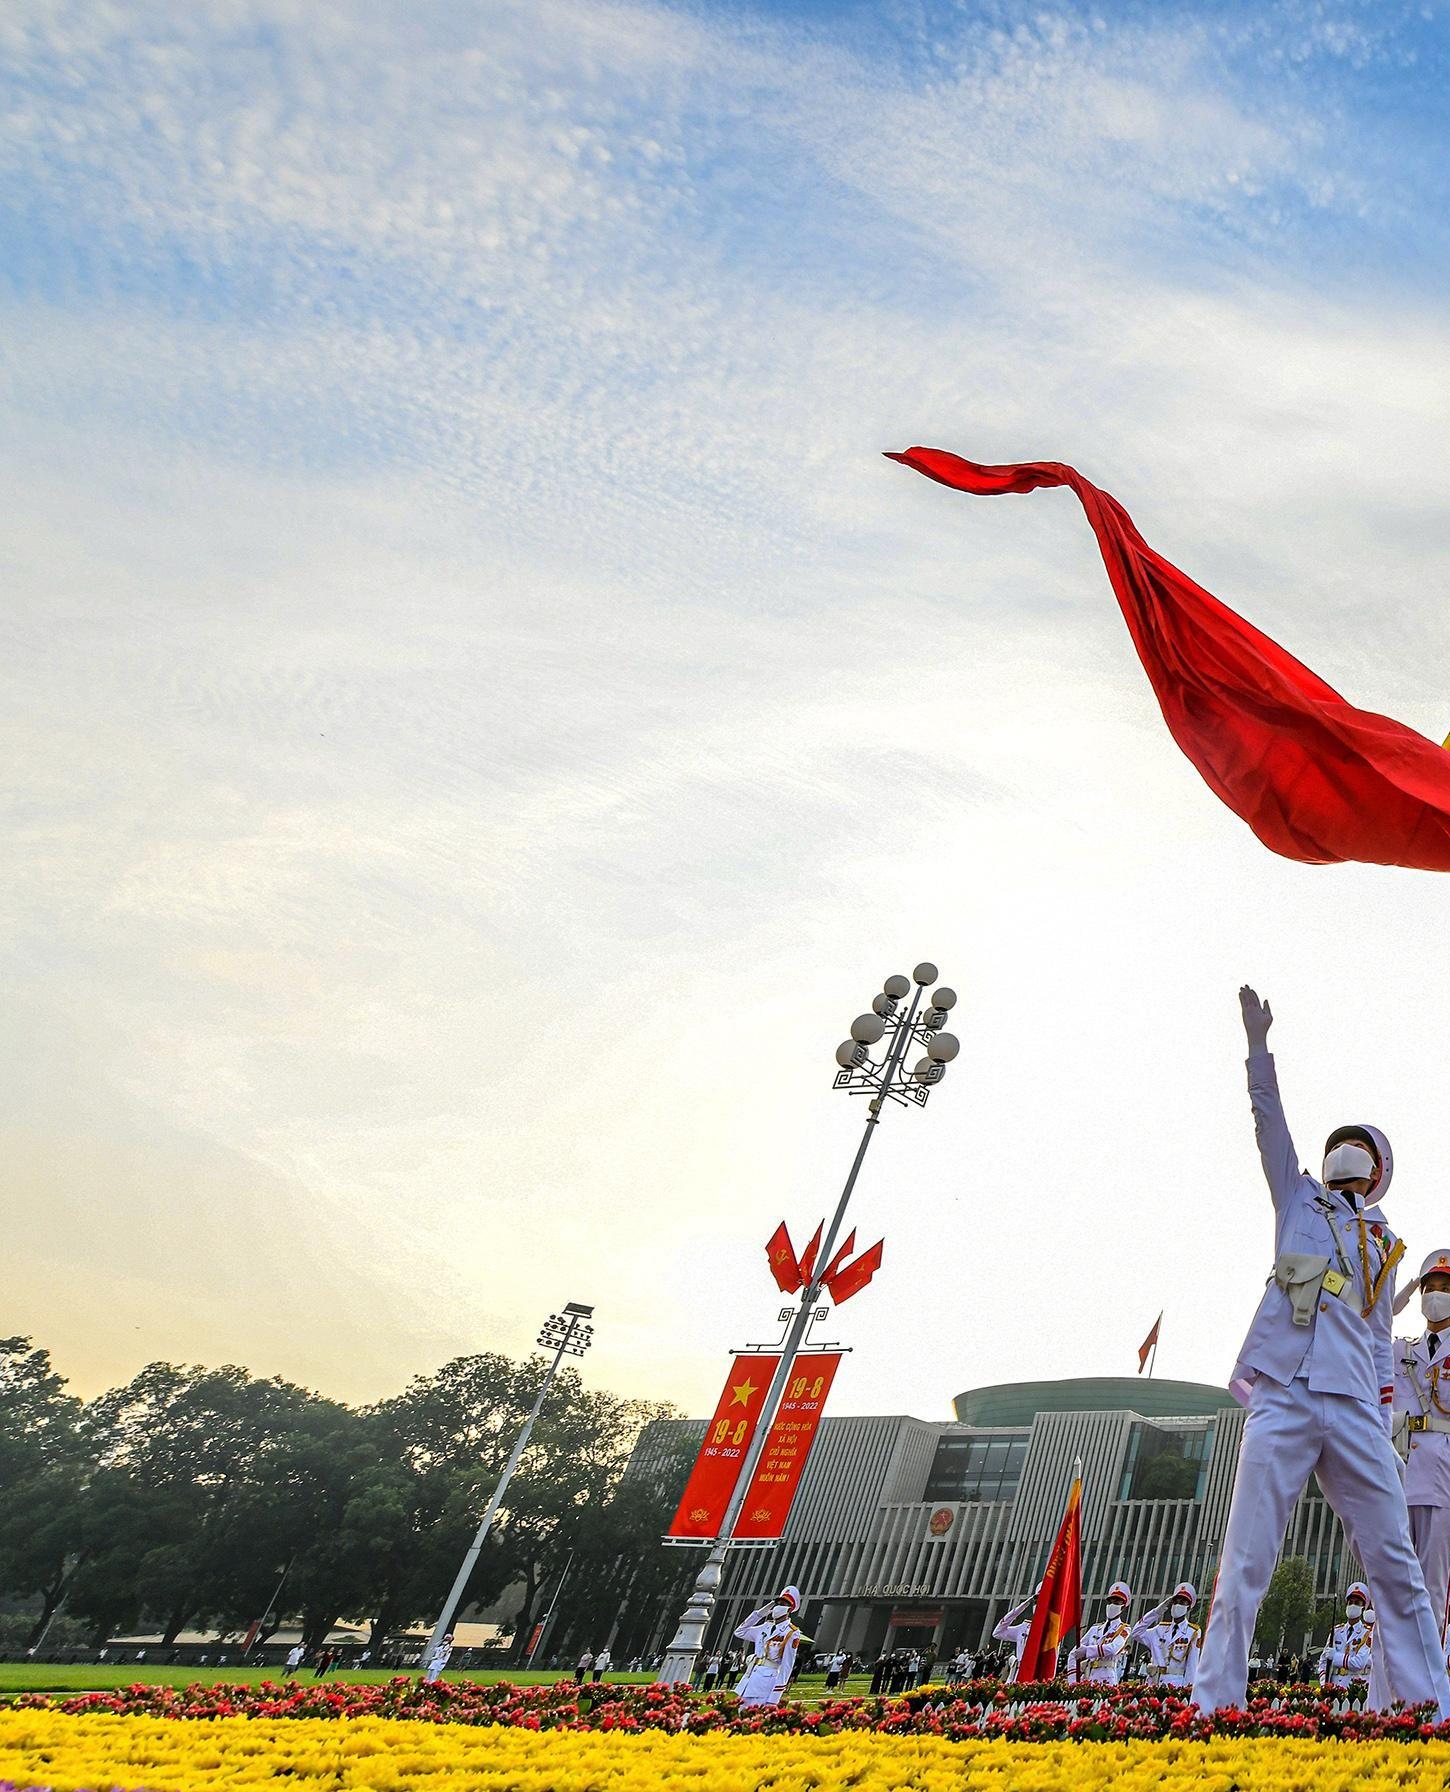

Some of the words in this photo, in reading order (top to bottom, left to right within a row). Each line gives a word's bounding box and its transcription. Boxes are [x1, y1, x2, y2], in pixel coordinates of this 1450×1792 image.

[788, 1376, 824, 1399] 19-8
[782, 1402, 796, 1410] 1945
[800, 1402, 818, 1410] 2022
[711, 1419, 748, 1445] 19-8
[704, 1448, 718, 1456] 1945
[721, 1448, 740, 1458] 2022
